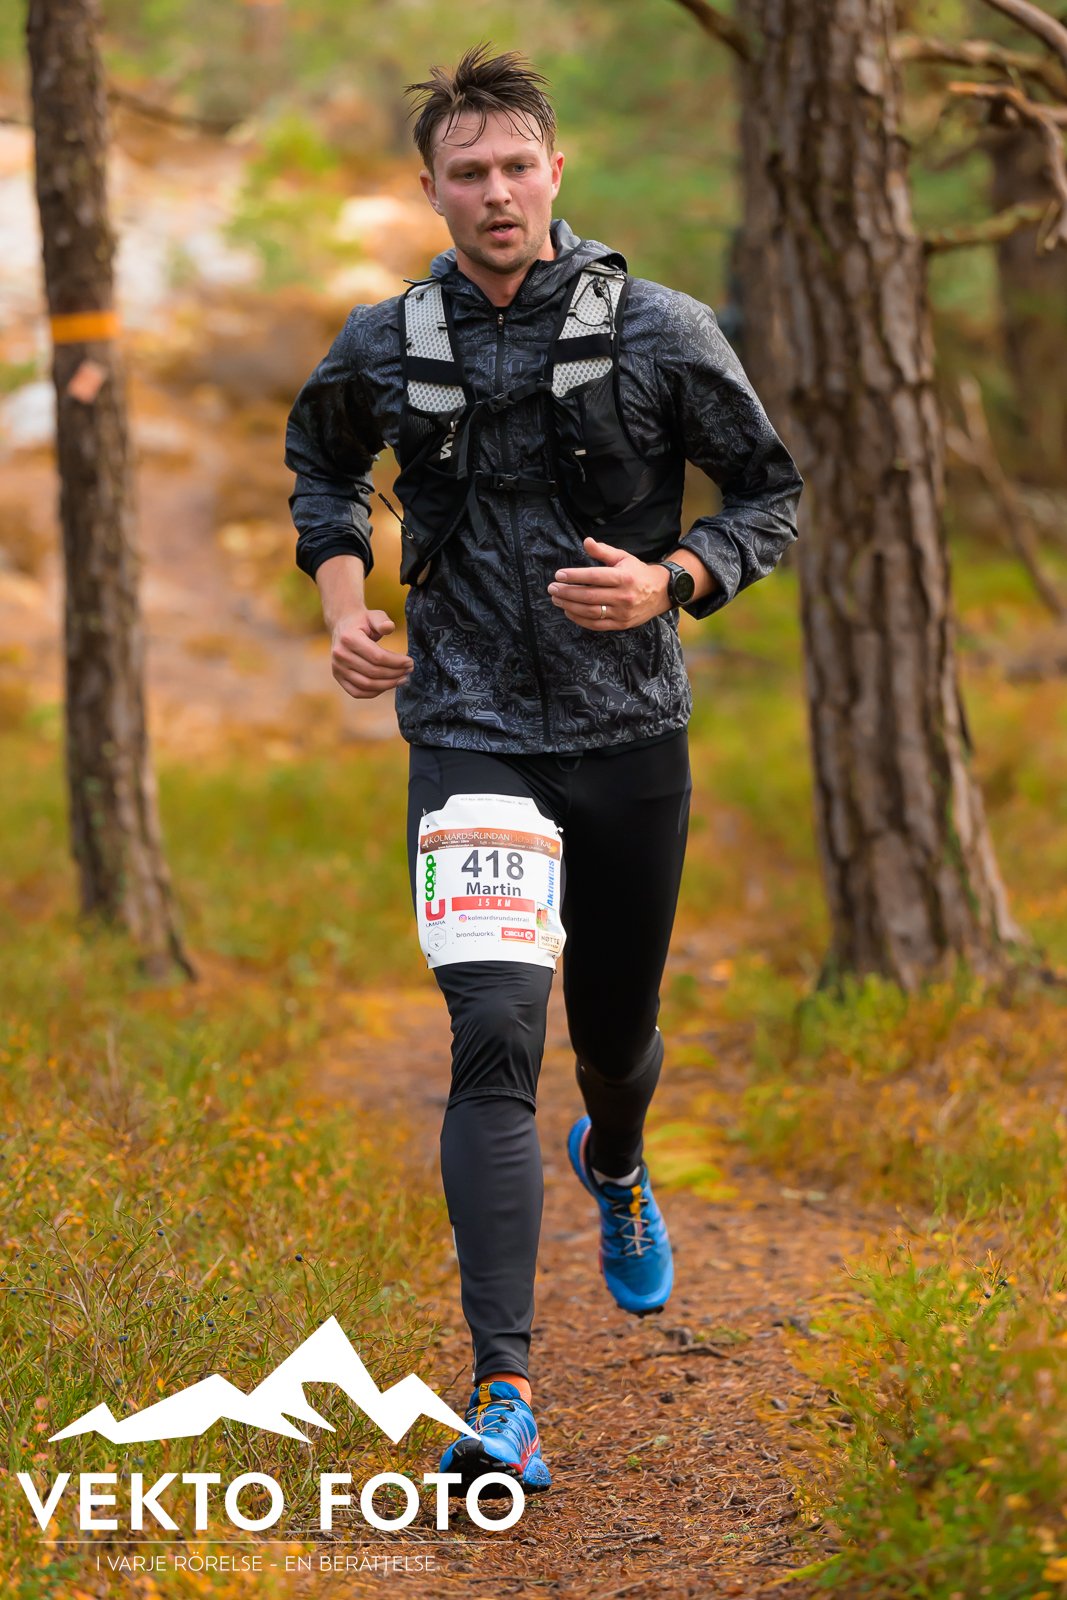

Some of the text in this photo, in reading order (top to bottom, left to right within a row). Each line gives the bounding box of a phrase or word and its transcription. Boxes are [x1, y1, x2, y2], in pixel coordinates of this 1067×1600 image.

[461, 850, 524, 880] 418
[425, 854, 436, 901] coop
[466, 882, 521, 896] Martin
[497, 898, 511, 907] KM
[503, 930, 525, 939] CIRCLE
